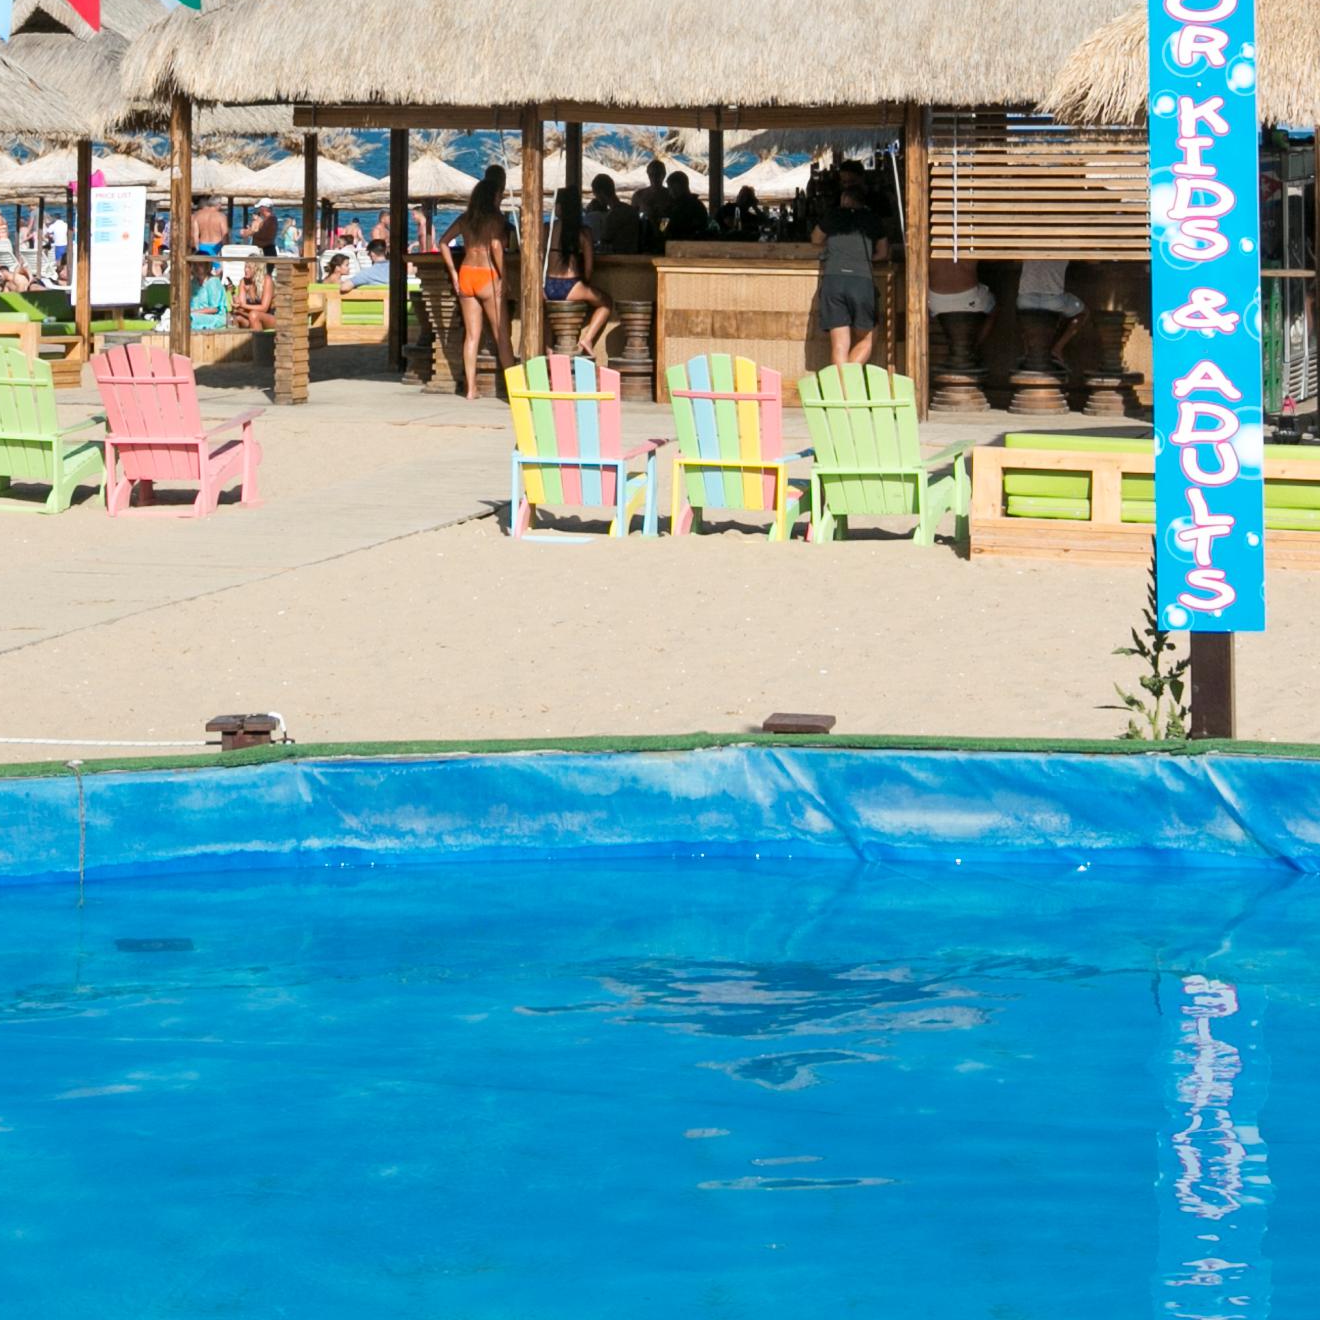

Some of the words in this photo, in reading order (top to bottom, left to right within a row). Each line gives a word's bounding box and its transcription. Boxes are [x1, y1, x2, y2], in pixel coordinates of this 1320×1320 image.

[1167, 95, 1236, 262] KIDS
[1171, 286, 1240, 333] &
[1170, 360, 1242, 611] ADULTS
